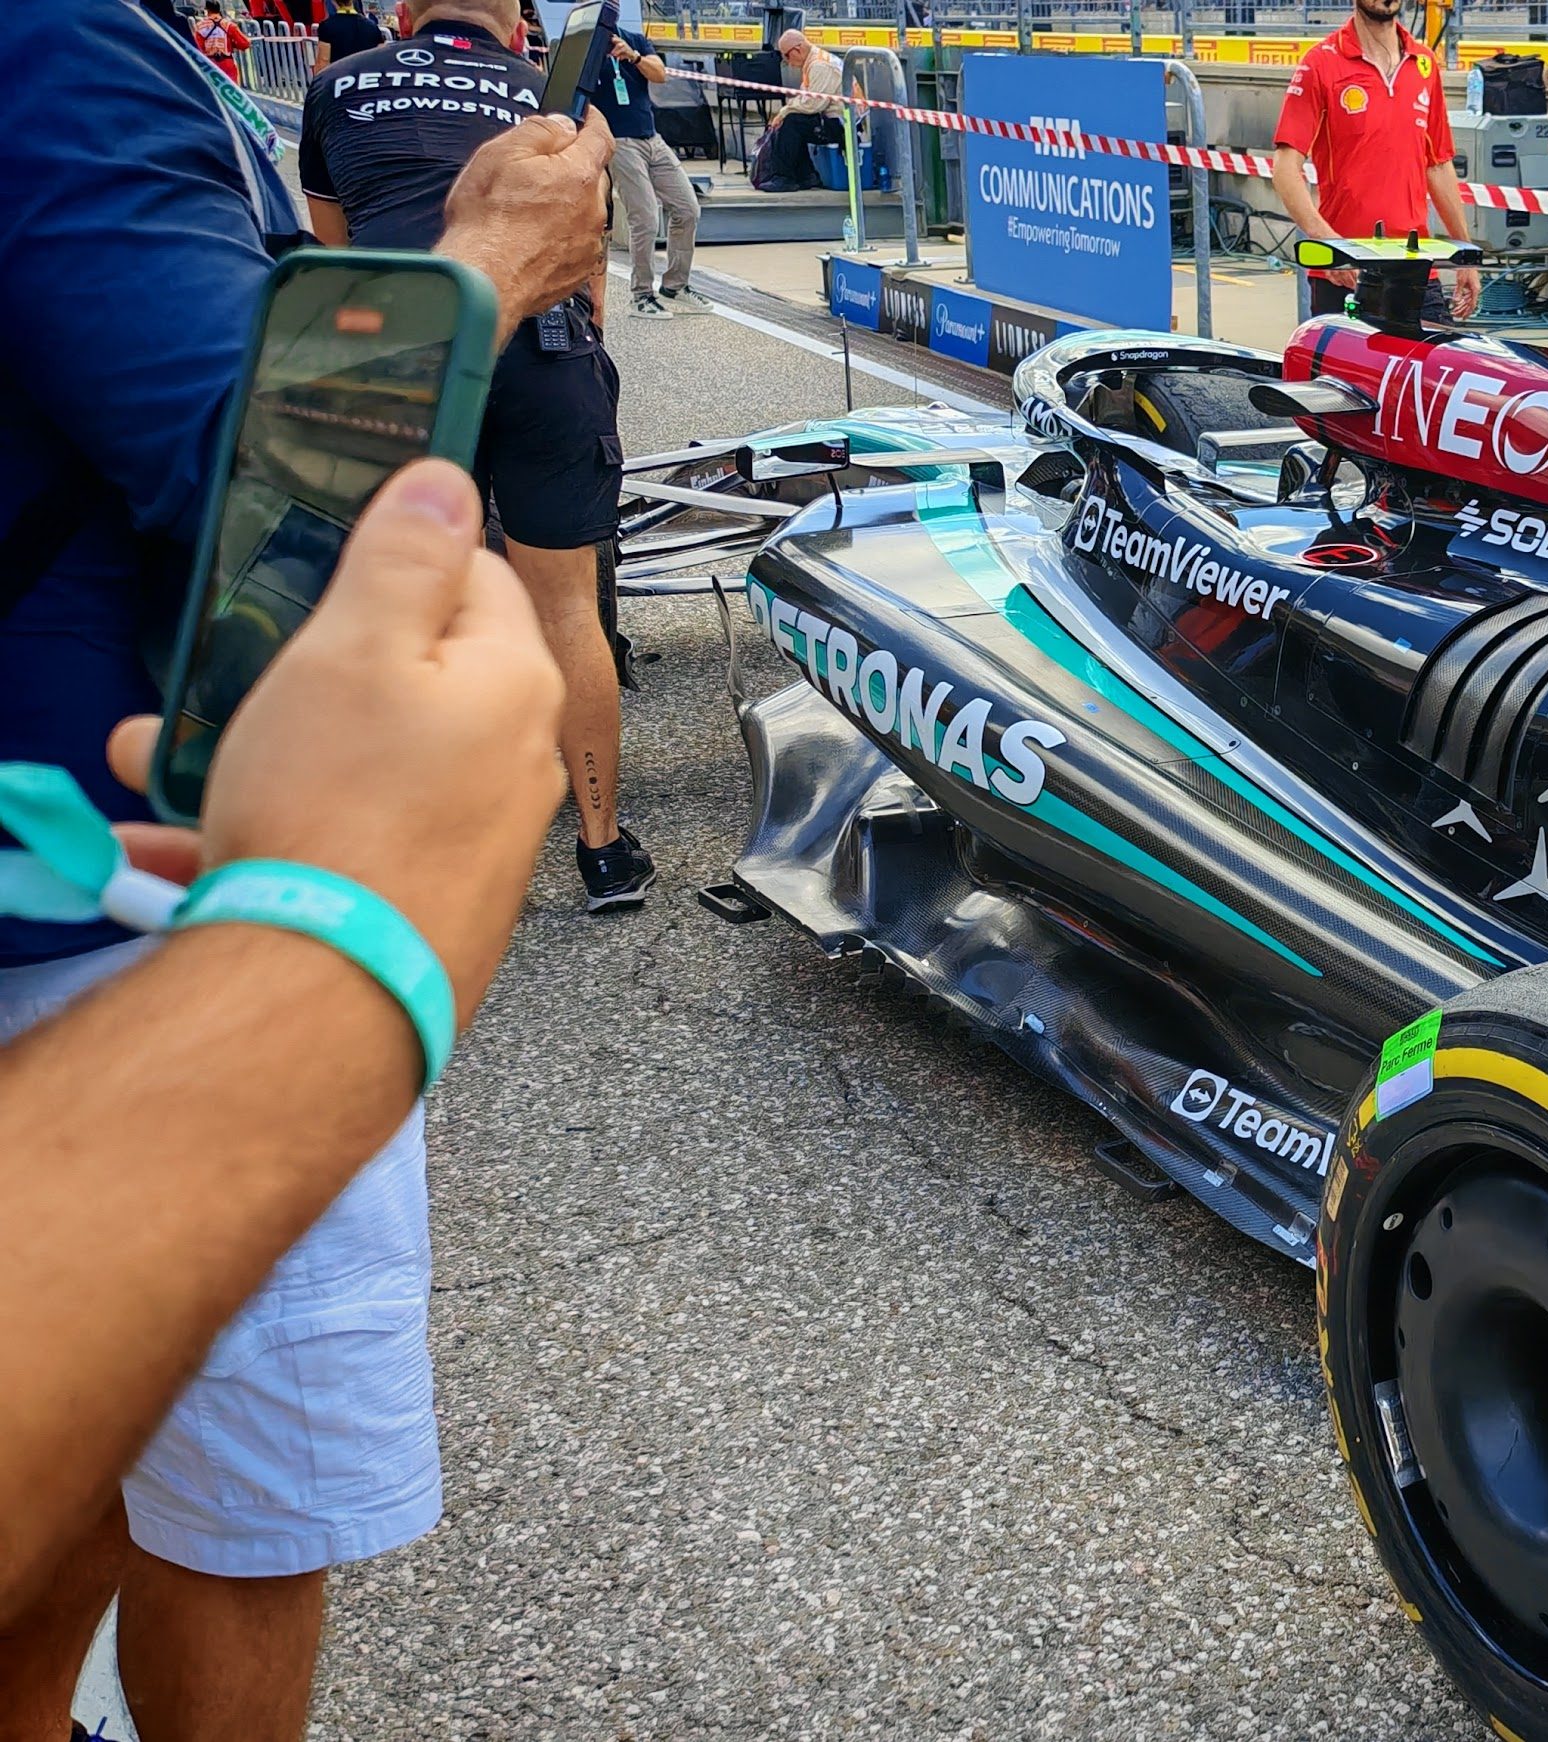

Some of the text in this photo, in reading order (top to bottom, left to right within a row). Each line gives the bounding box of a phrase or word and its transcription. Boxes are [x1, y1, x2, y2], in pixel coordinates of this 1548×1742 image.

[334, 72, 540, 109] PETRONA
[358, 97, 523, 125] CROWDSTRI
[1030, 116, 1086, 160] TATA
[980, 164, 1155, 229] COMMUNICATIONS
[1008, 215, 1121, 257] #EmpoweringTomorrow
[936, 303, 986, 344] Paramount+
[1120, 351, 1169, 361] Snapdragon
[1101, 508, 1291, 620] TeamViewer
[750, 582, 1067, 806] PETRONAS
